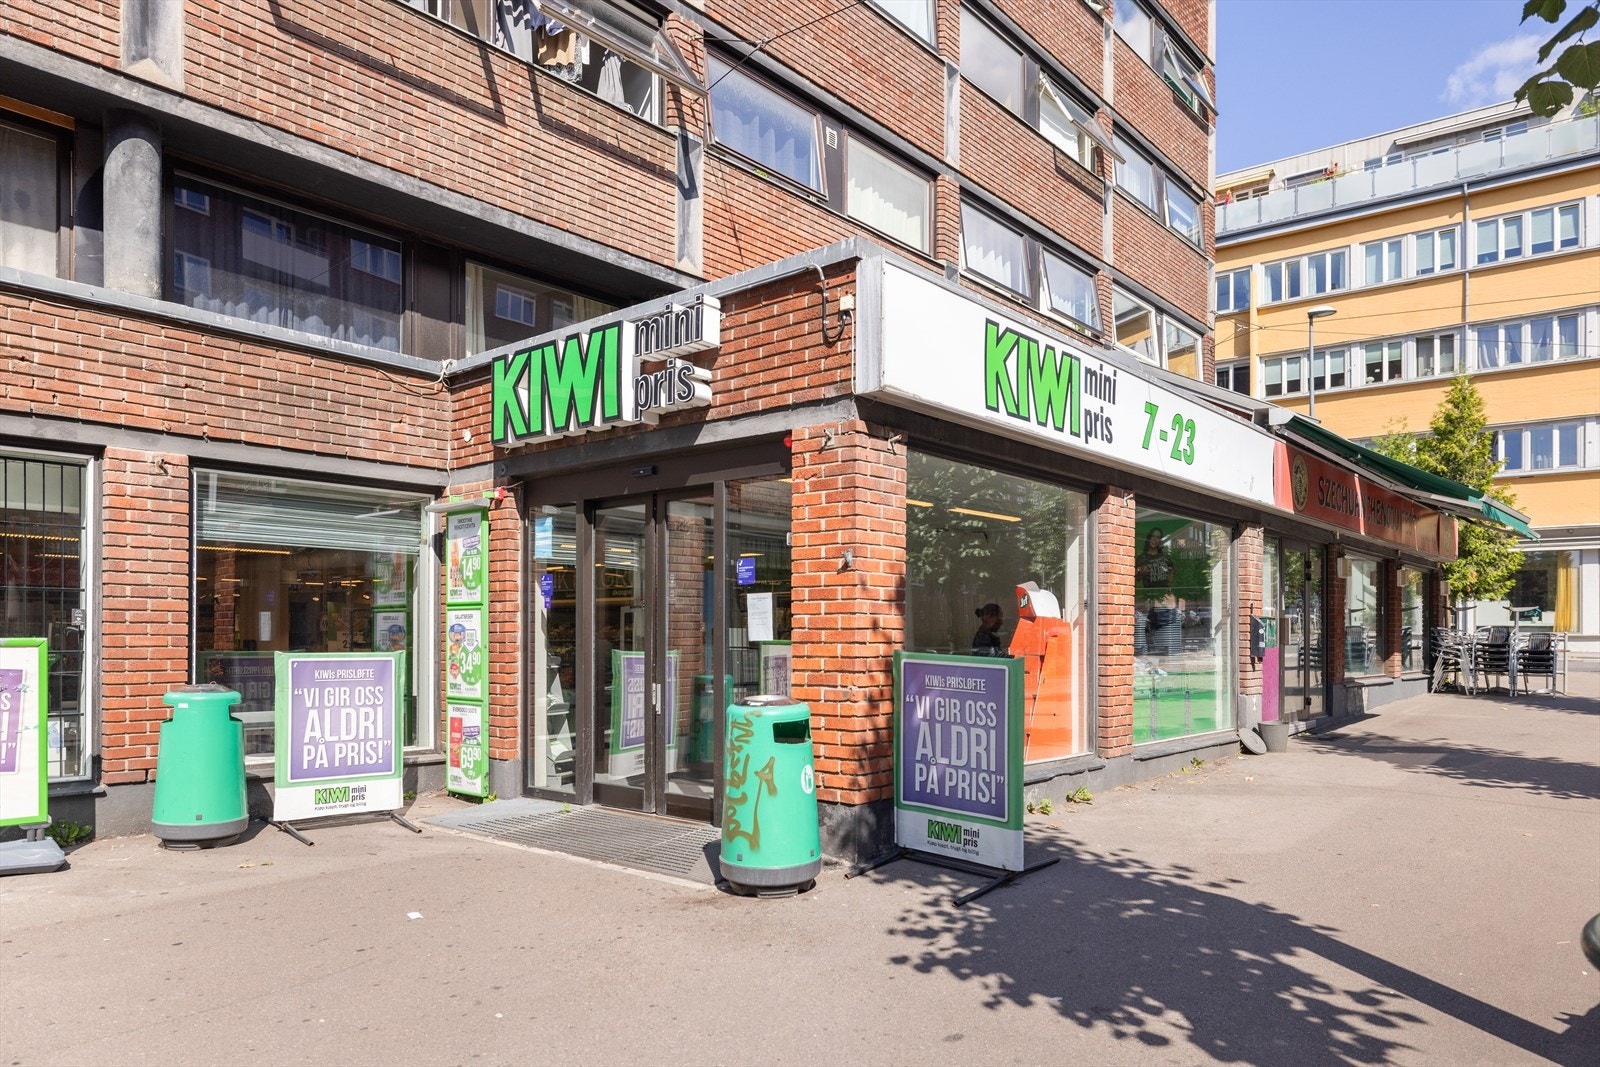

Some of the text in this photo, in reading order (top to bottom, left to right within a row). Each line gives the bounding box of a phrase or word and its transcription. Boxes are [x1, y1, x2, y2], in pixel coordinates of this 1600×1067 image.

[634, 293, 704, 357] mini
[492, 320, 623, 445] KIWI
[634, 358, 695, 421] pris
[985, 318, 1081, 438] KIWI
[1084, 363, 1117, 405] mini
[1084, 406, 1113, 444] pris
[314, 668, 375, 680] KIWIs PRISLØFTE
[924, 674, 986, 691] KIWIs PRISLØFTE
[324, 687, 350, 707] GIR
[355, 685, 384, 706] OSS
[303, 706, 383, 744] ALDRI
[934, 697, 961, 723] GIR
[965, 700, 997, 728] OSS
[302, 737, 329, 770] PÅ
[915, 721, 996, 772] ALDRI
[351, 785, 367, 794] mini
[914, 757, 940, 795] PÅ
[315, 786, 350, 805] KIWI
[351, 792, 366, 803] pris
[928, 819, 962, 844] KIWI
[963, 828, 980, 839] mini
[963, 837, 978, 848] pris
